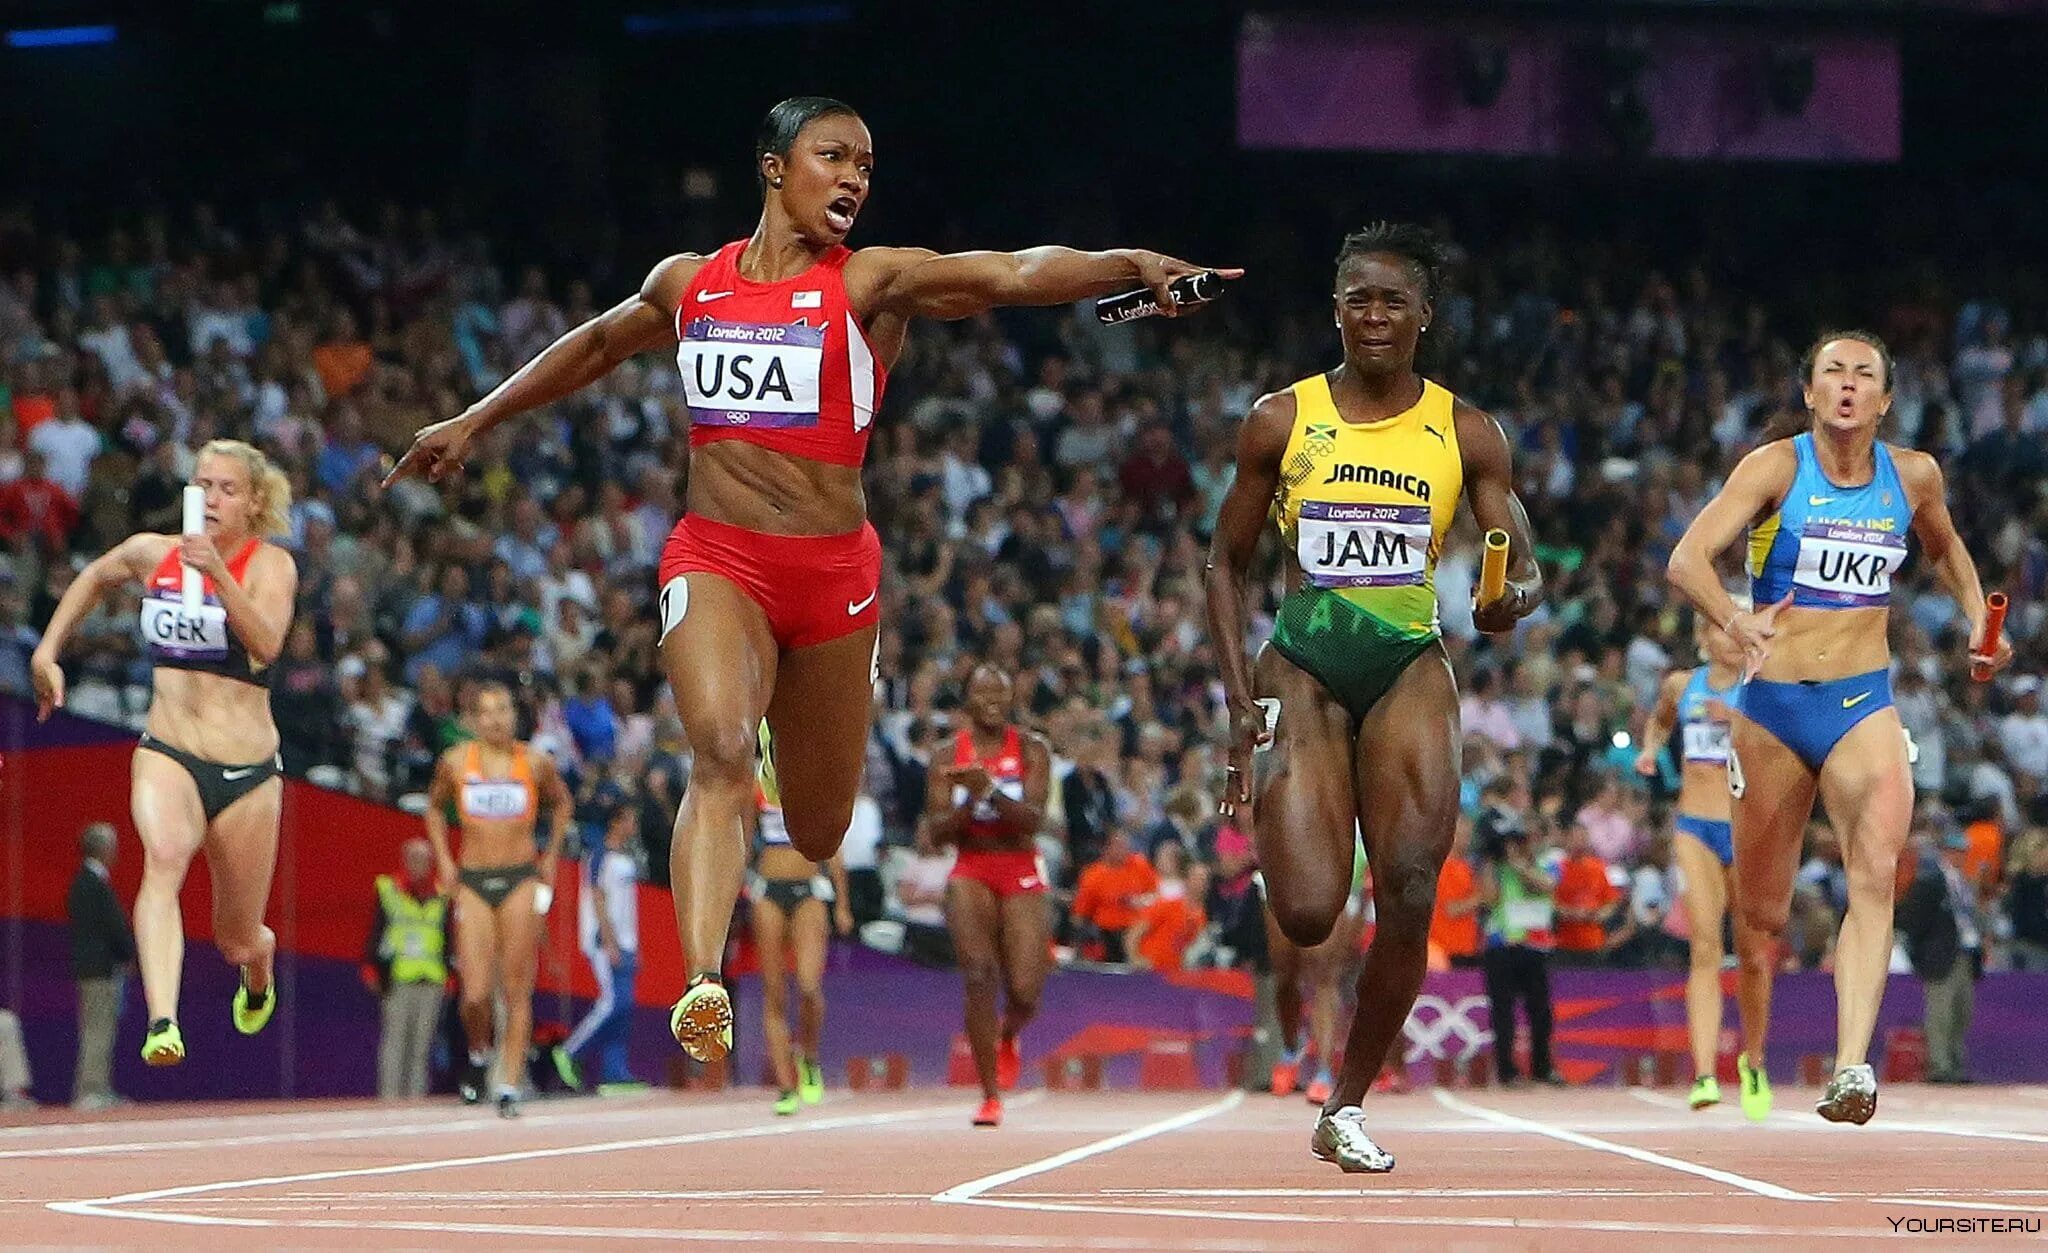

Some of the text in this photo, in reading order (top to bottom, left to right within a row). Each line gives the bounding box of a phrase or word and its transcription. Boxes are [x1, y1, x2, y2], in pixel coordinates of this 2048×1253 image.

[706, 325, 786, 342] London 2012
[695, 353, 794, 402] USA
[1323, 463, 1432, 503] JAMAICA
[1327, 507, 1400, 521] London 2012
[1316, 530, 1410, 568] JAM
[1818, 549, 1888, 587] UKR
[154, 609, 207, 643] GER
